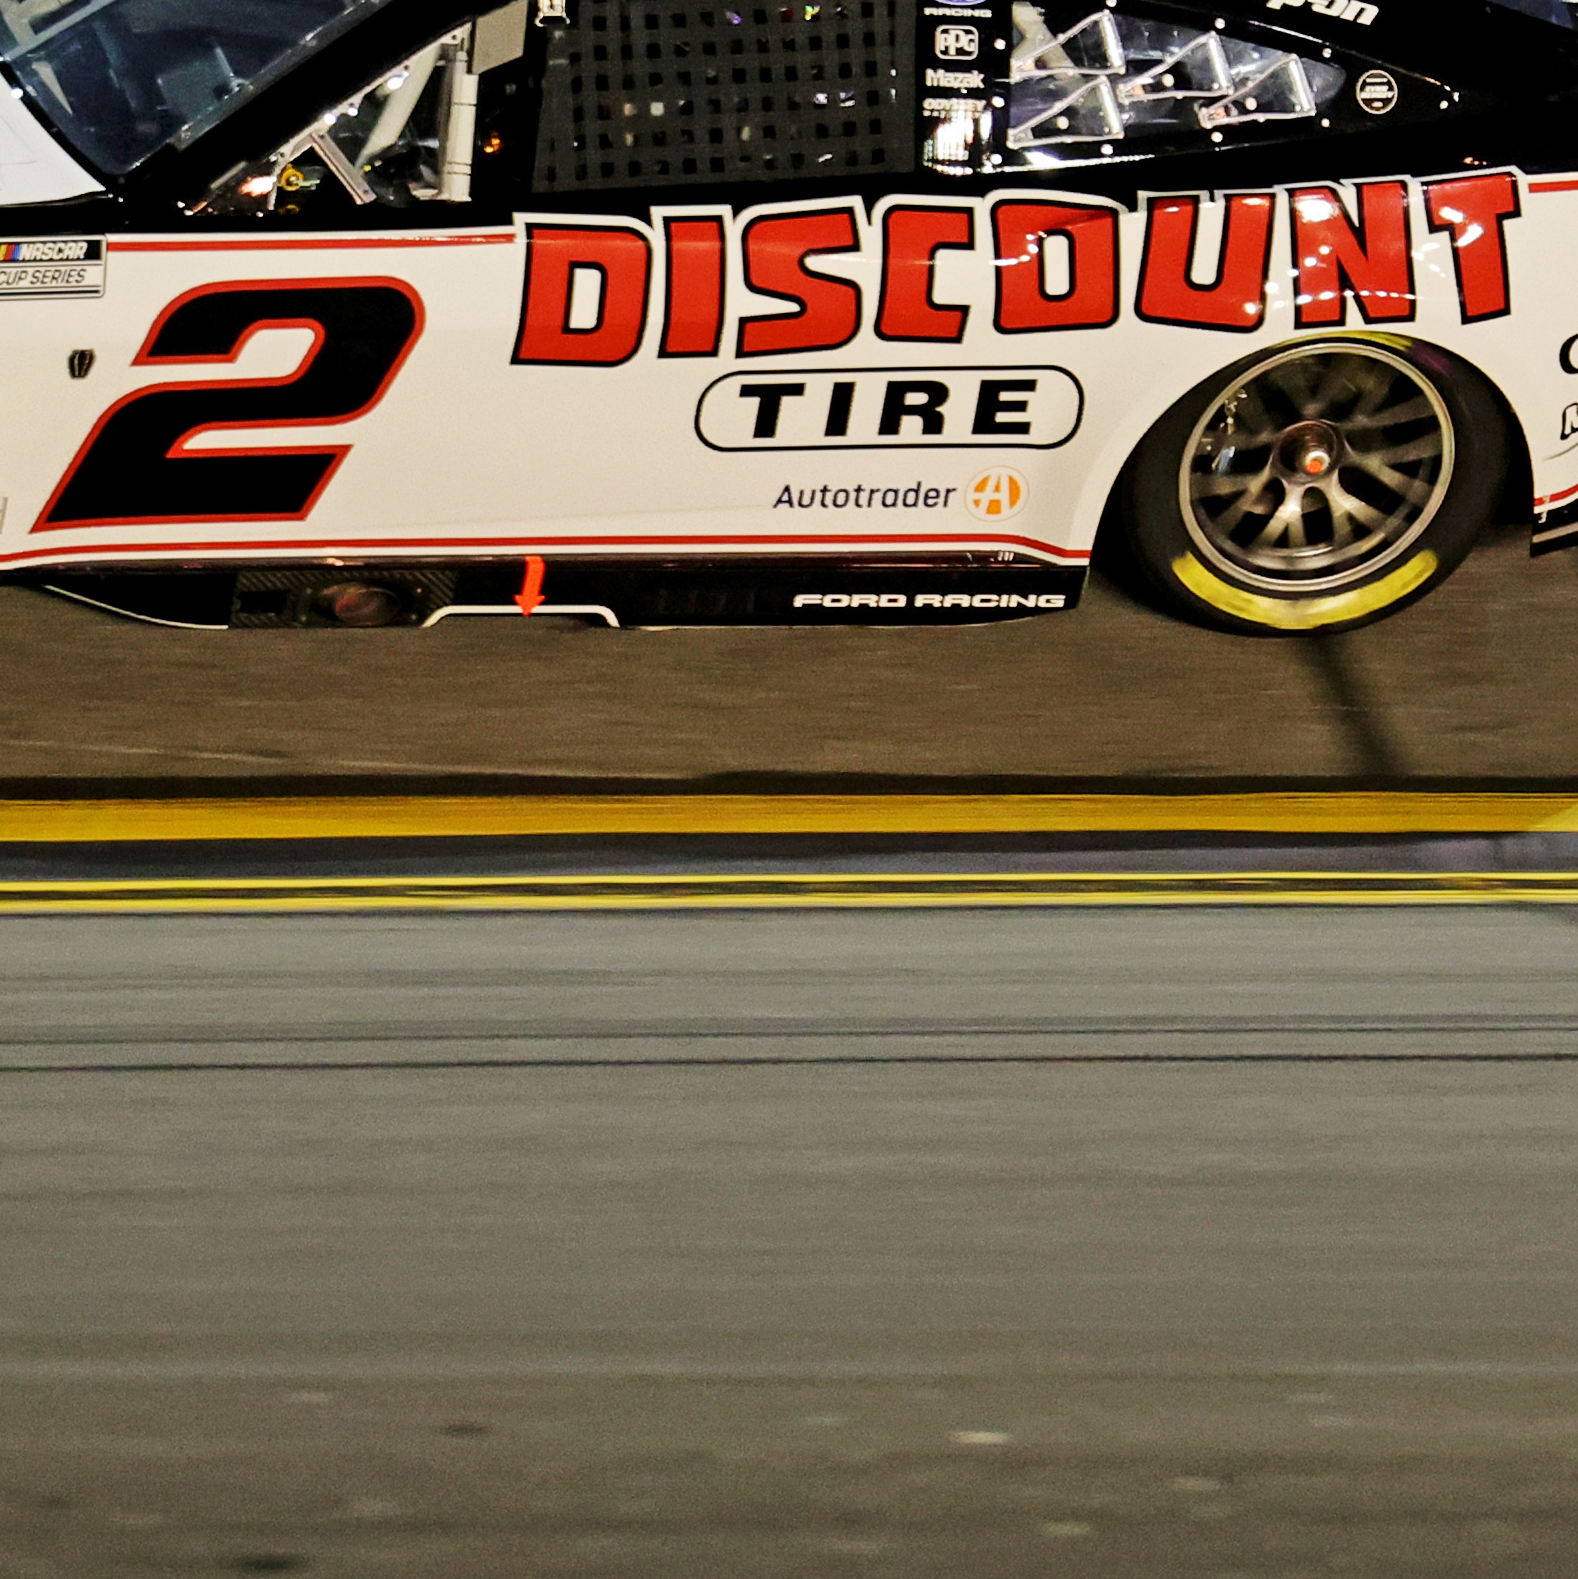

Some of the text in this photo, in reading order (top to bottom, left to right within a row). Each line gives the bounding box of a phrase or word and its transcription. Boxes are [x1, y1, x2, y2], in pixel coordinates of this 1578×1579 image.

[923, 7, 992, 18] RACING
[939, 29, 976, 56] PPG
[925, 67, 985, 89] Mazak
[19, 241, 88, 261] NASCAR
[30, 268, 87, 284] SERIES
[509, 171, 1522, 367] DISCOUNT
[29, 275, 426, 534] 2
[738, 379, 1038, 438] TIRE
[773, 481, 957, 509] Autotrader
[793, 594, 1066, 608] FORD RACING
